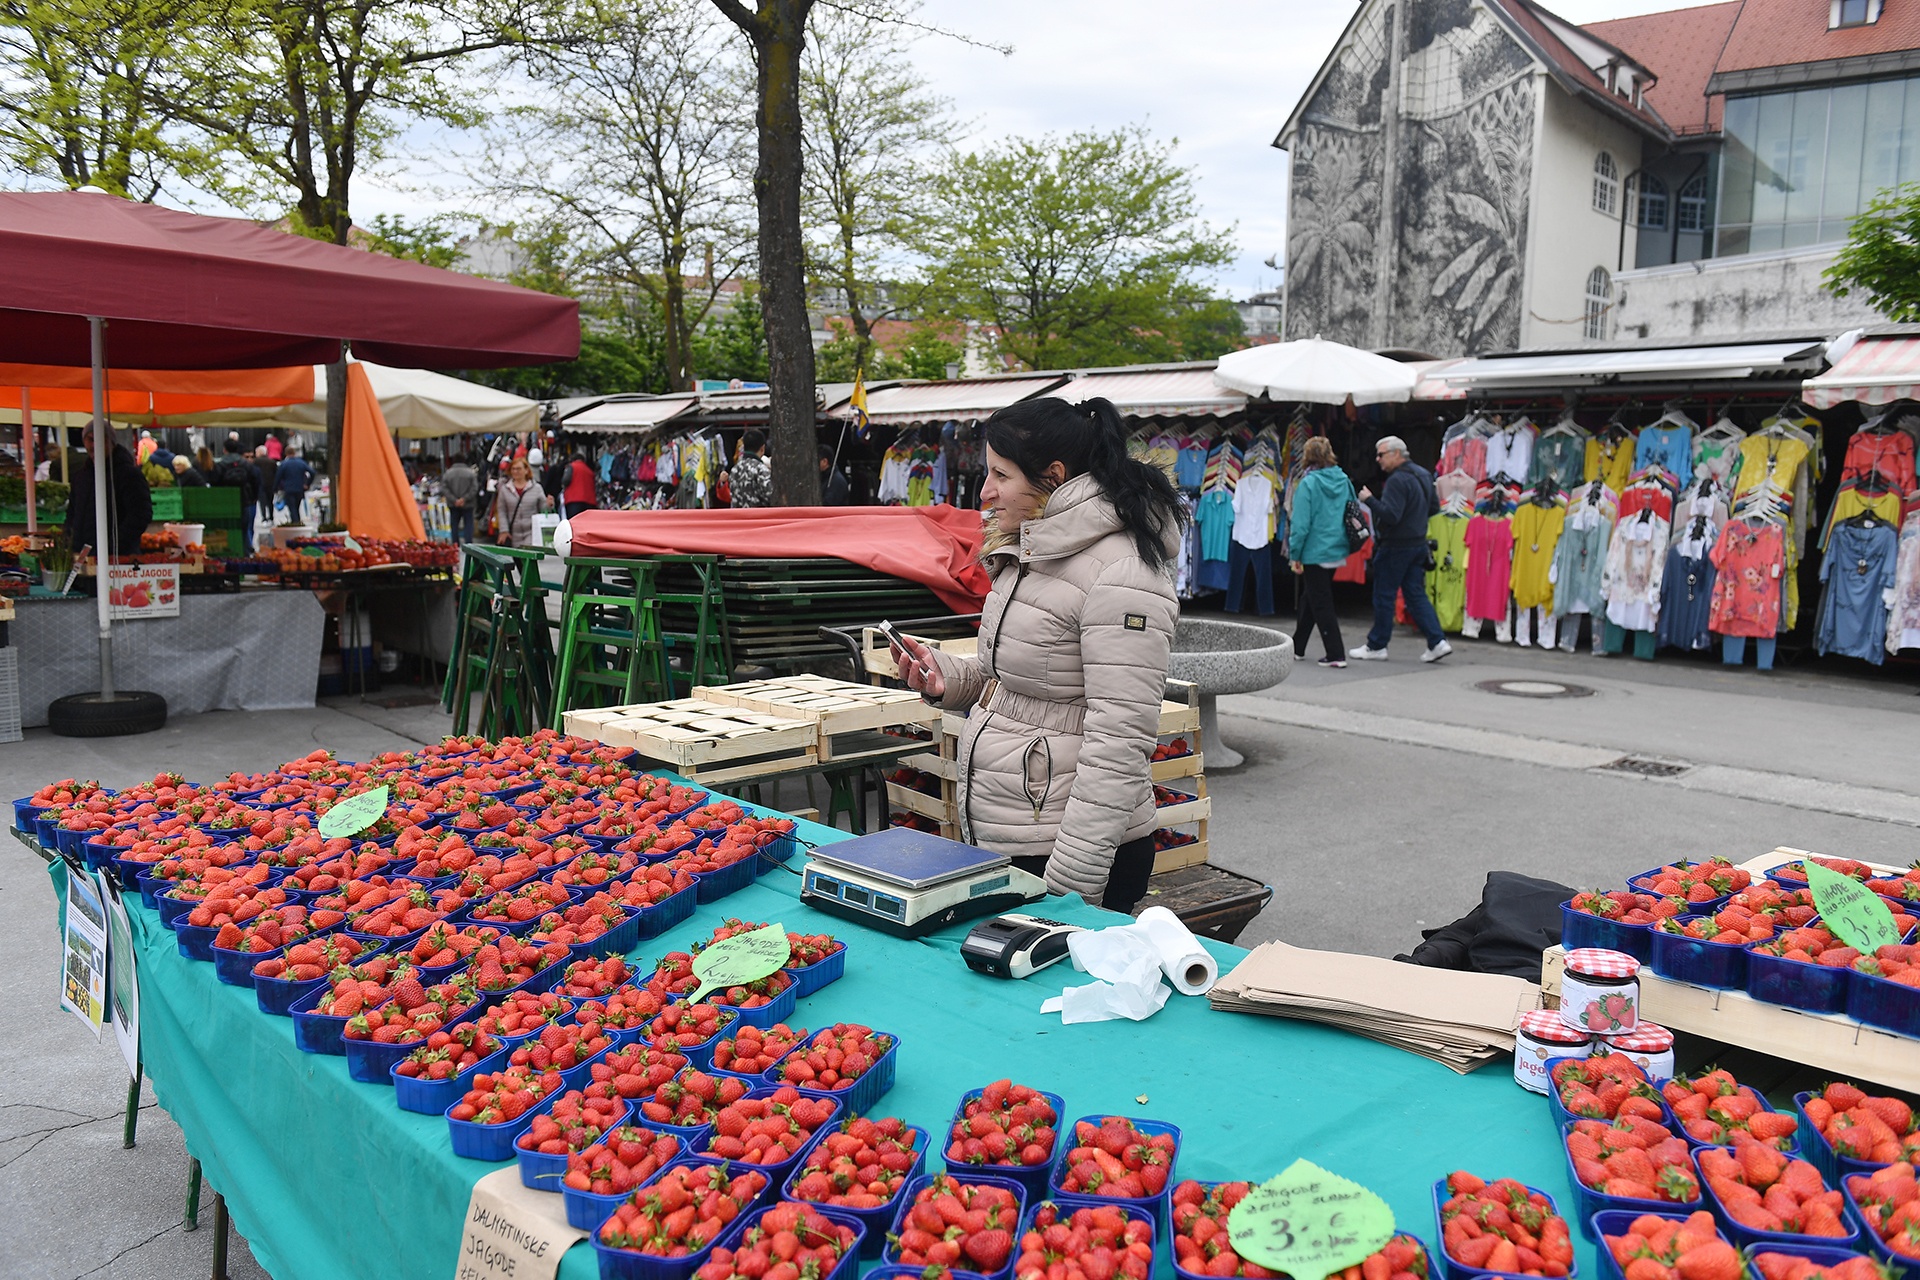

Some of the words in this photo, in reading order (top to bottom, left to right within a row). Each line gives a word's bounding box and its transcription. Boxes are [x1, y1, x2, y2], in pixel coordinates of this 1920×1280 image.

[109, 568, 138, 578] OMAČE
[141, 569, 173, 578] JAGODE
[736, 936, 782, 949] JAGODE
[1254, 1182, 1321, 1199] JAGODE
[472, 1203, 550, 1258] DALMATINSKE
[466, 1234, 516, 1278] JAGODE
